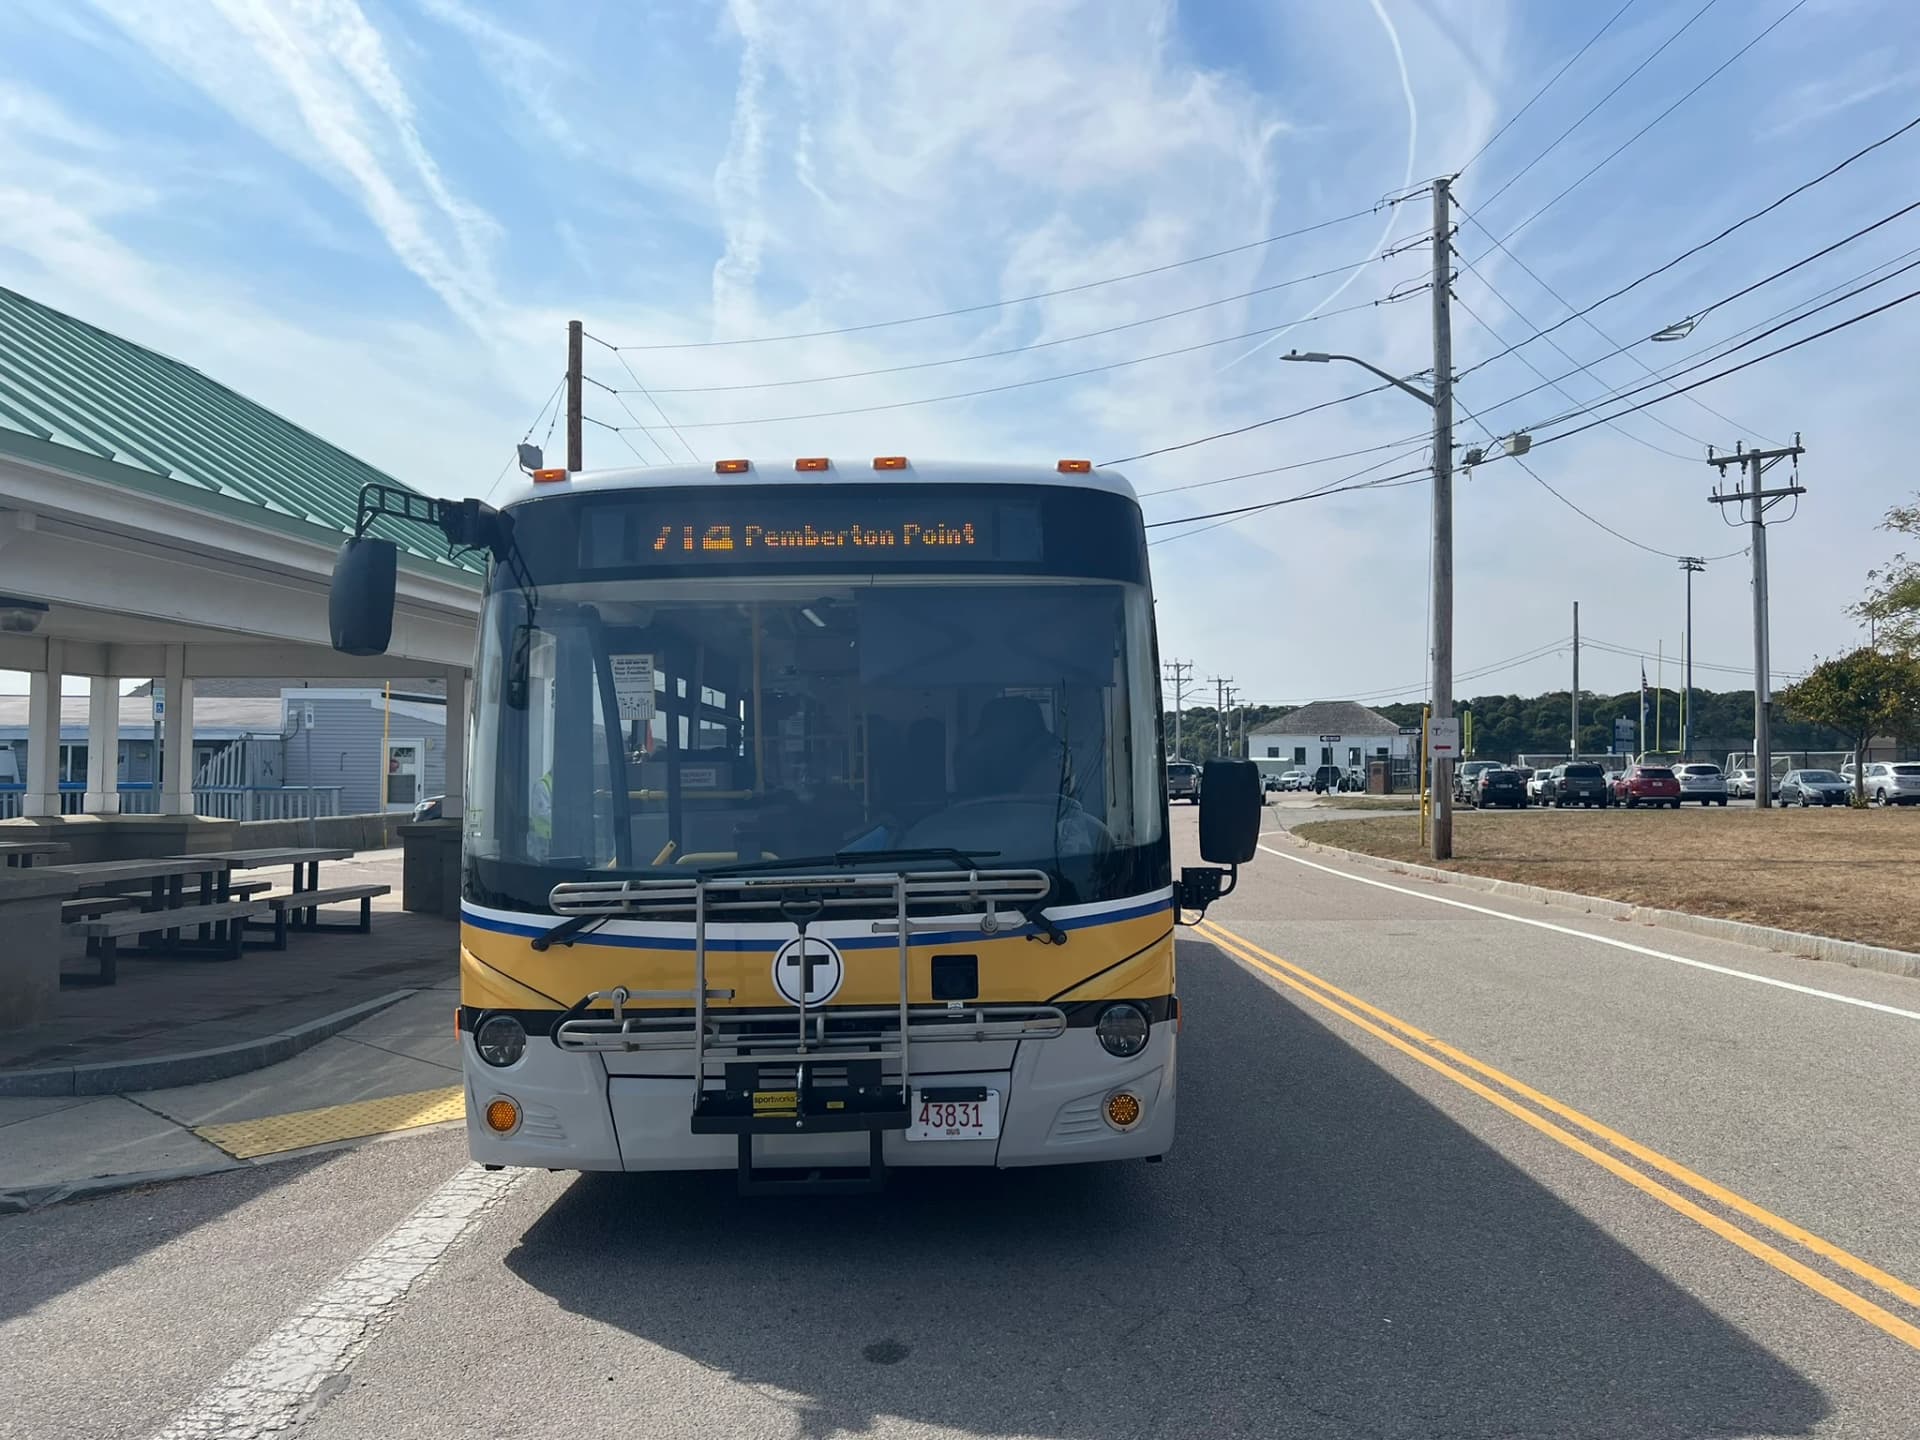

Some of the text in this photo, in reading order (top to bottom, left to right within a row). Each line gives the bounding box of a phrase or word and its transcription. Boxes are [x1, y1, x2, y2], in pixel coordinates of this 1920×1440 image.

[746, 524, 894, 546] Pemberton
[904, 523, 975, 545] Point
[787, 955, 829, 993] T
[919, 1103, 983, 1127] 43831
